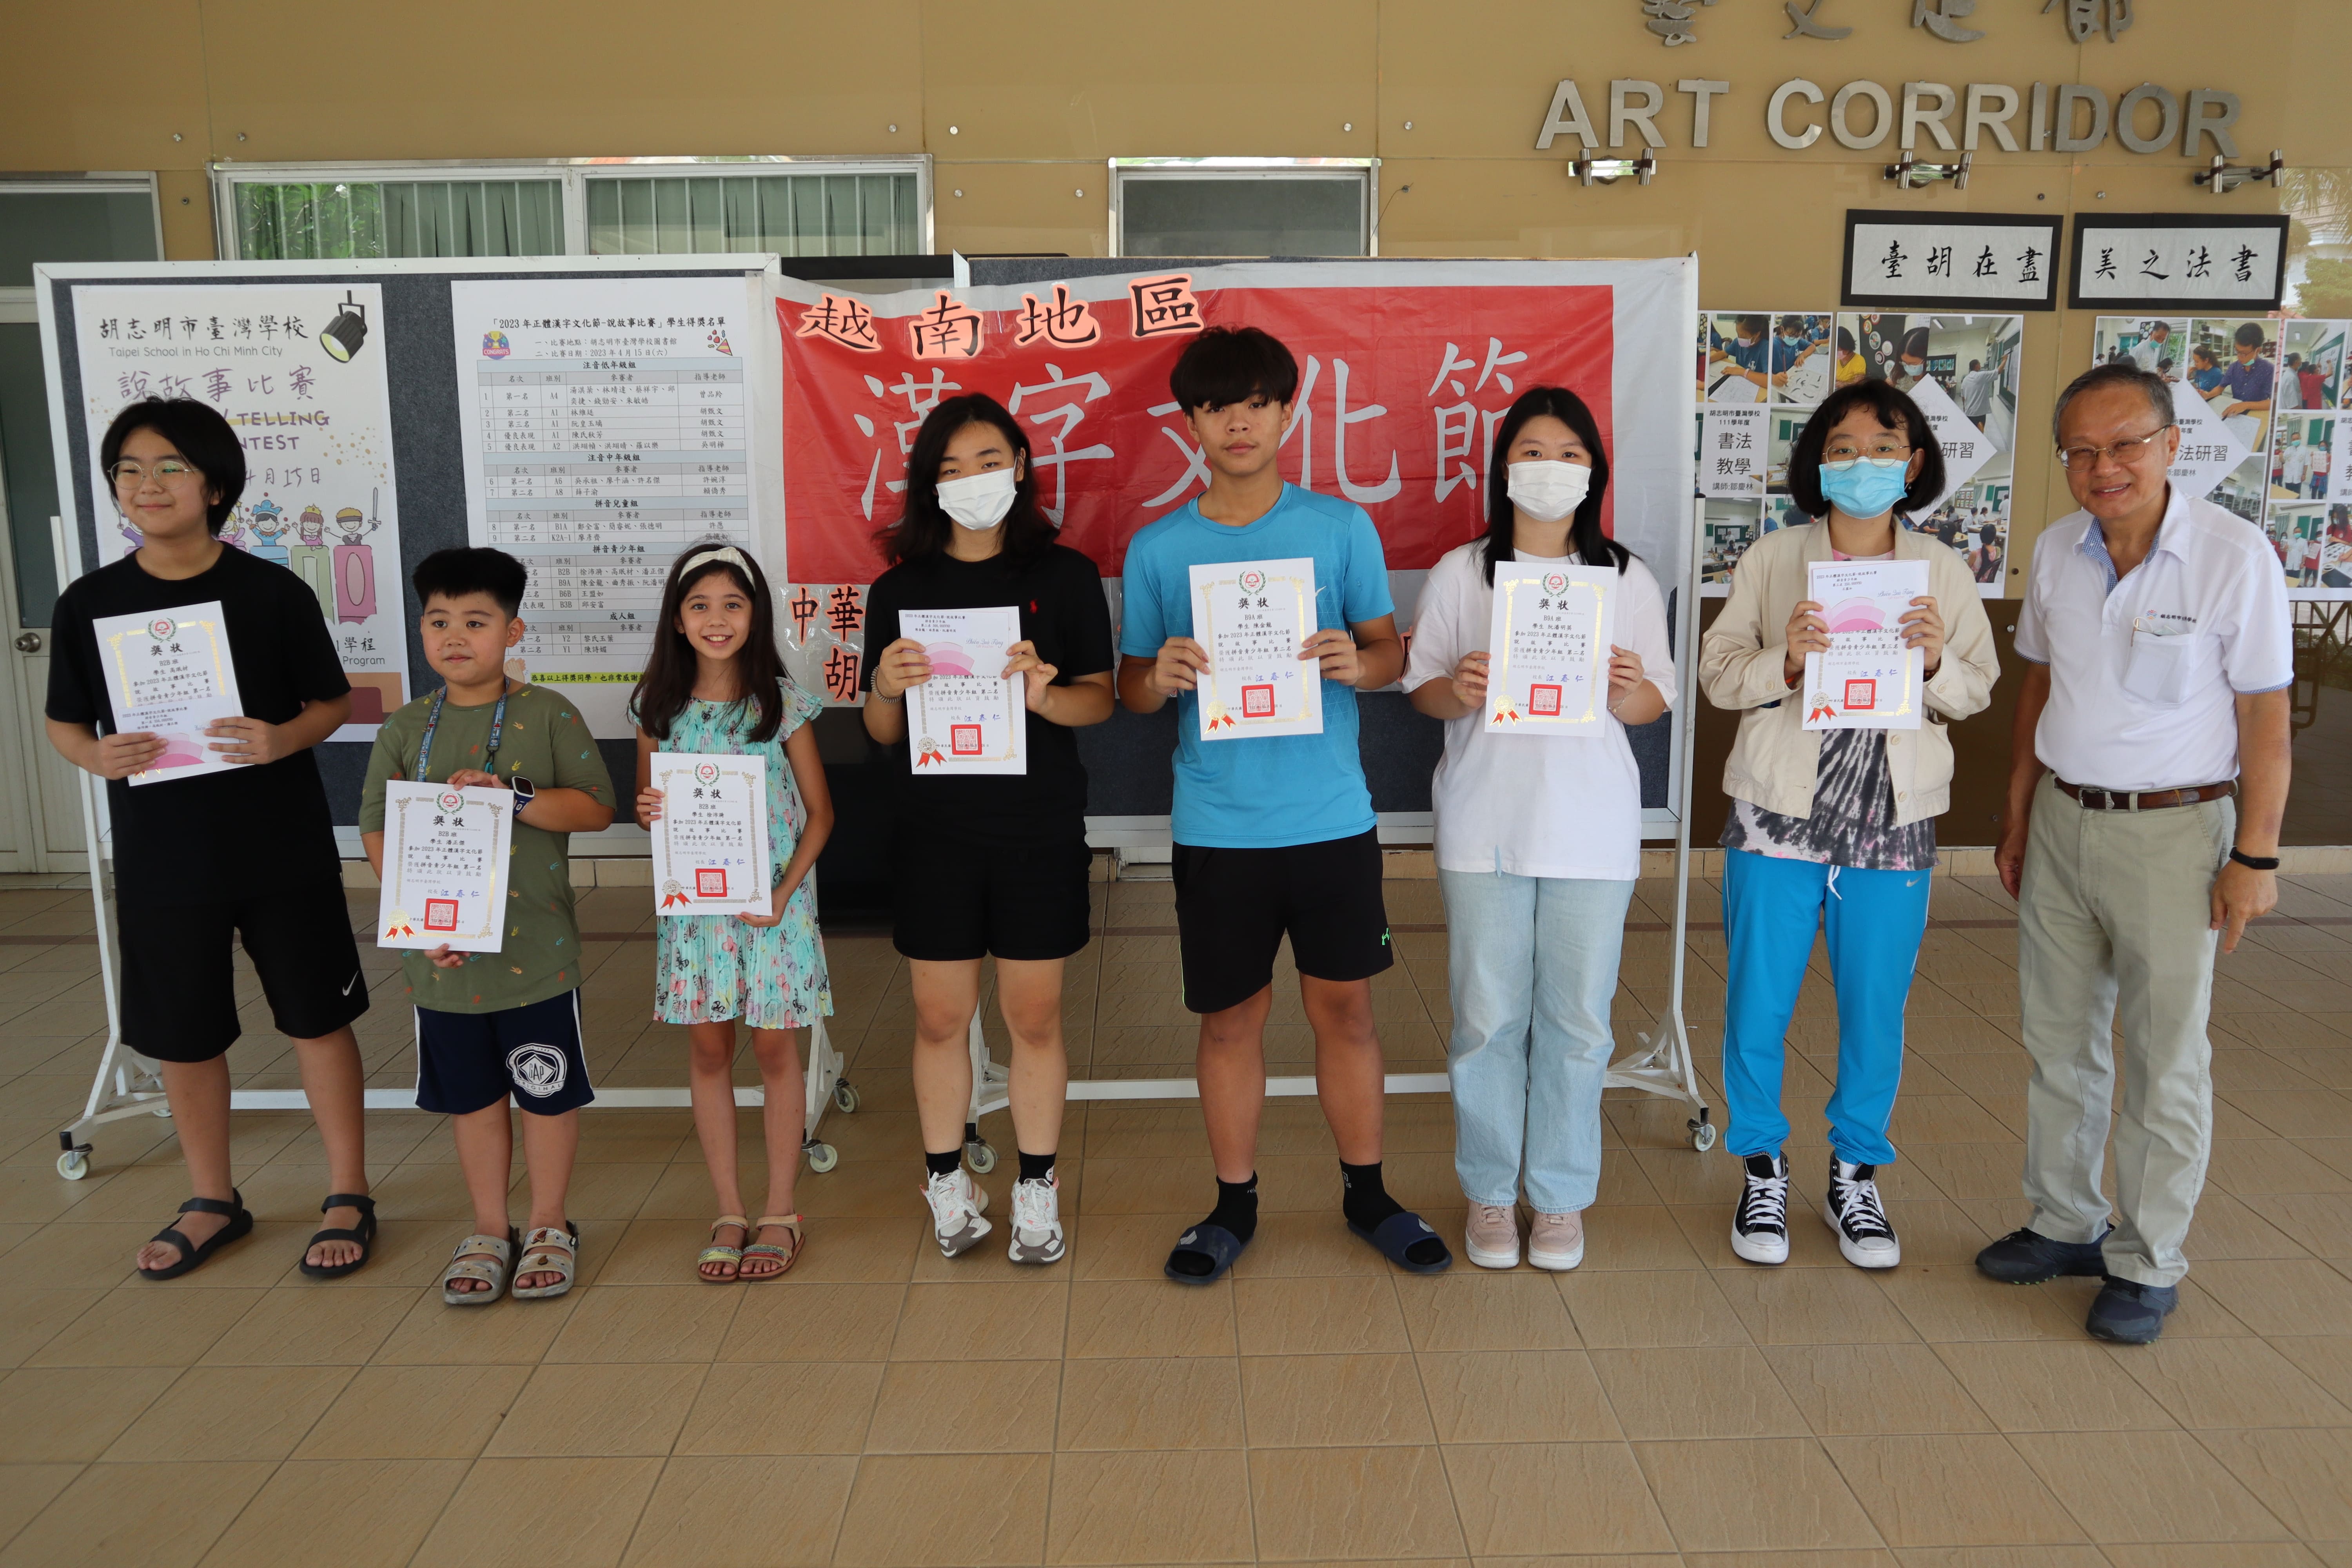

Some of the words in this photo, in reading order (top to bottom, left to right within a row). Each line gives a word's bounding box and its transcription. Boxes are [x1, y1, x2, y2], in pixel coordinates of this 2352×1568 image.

[1535, 78, 1729, 149] ART
[1766, 77, 2241, 157] CORRIDOR
[800, 277, 1202, 356] 越南地區
[100, 316, 309, 341] 胡志明市臺灣學校
[109, 347, 140, 358] Taipei
[144, 347, 179, 357] School
[183, 347, 191, 356] in
[196, 347, 210, 356] Ho
[214, 347, 230, 356] Chi
[234, 346, 258, 356] Minh
[261, 346, 283, 358] City
[583, 361, 636, 370] 注音低年級組
[118, 365, 316, 402] 說故事比賽
[611, 373, 633, 381] 參賽者
[236, 410, 330, 427] TELLING
[239, 434, 299, 450] NTEST
[1719, 432, 1752, 449] 書法
[588, 453, 641, 462] 注音中年級組
[1942, 443, 1974, 458] 研習
[2179, 445, 2228, 461] 法研習
[1717, 458, 1750, 475] 教學
[1238, 597, 1269, 609] 獎狀
[1539, 598, 1569, 610] 獎狀
[792, 586, 863, 643] 中華
[150, 643, 183, 656] 獎狀
[336, 636, 376, 653] 學程
[343, 656, 385, 666] Program
[531, 674, 641, 682] 恭喜以上得獎同學，也非常感謝
[825, 648, 859, 701] 胡
[693, 788, 722, 799] 獎狀
[433, 815, 464, 827] 獎狀
[529, 1063, 544, 1081] GAP
